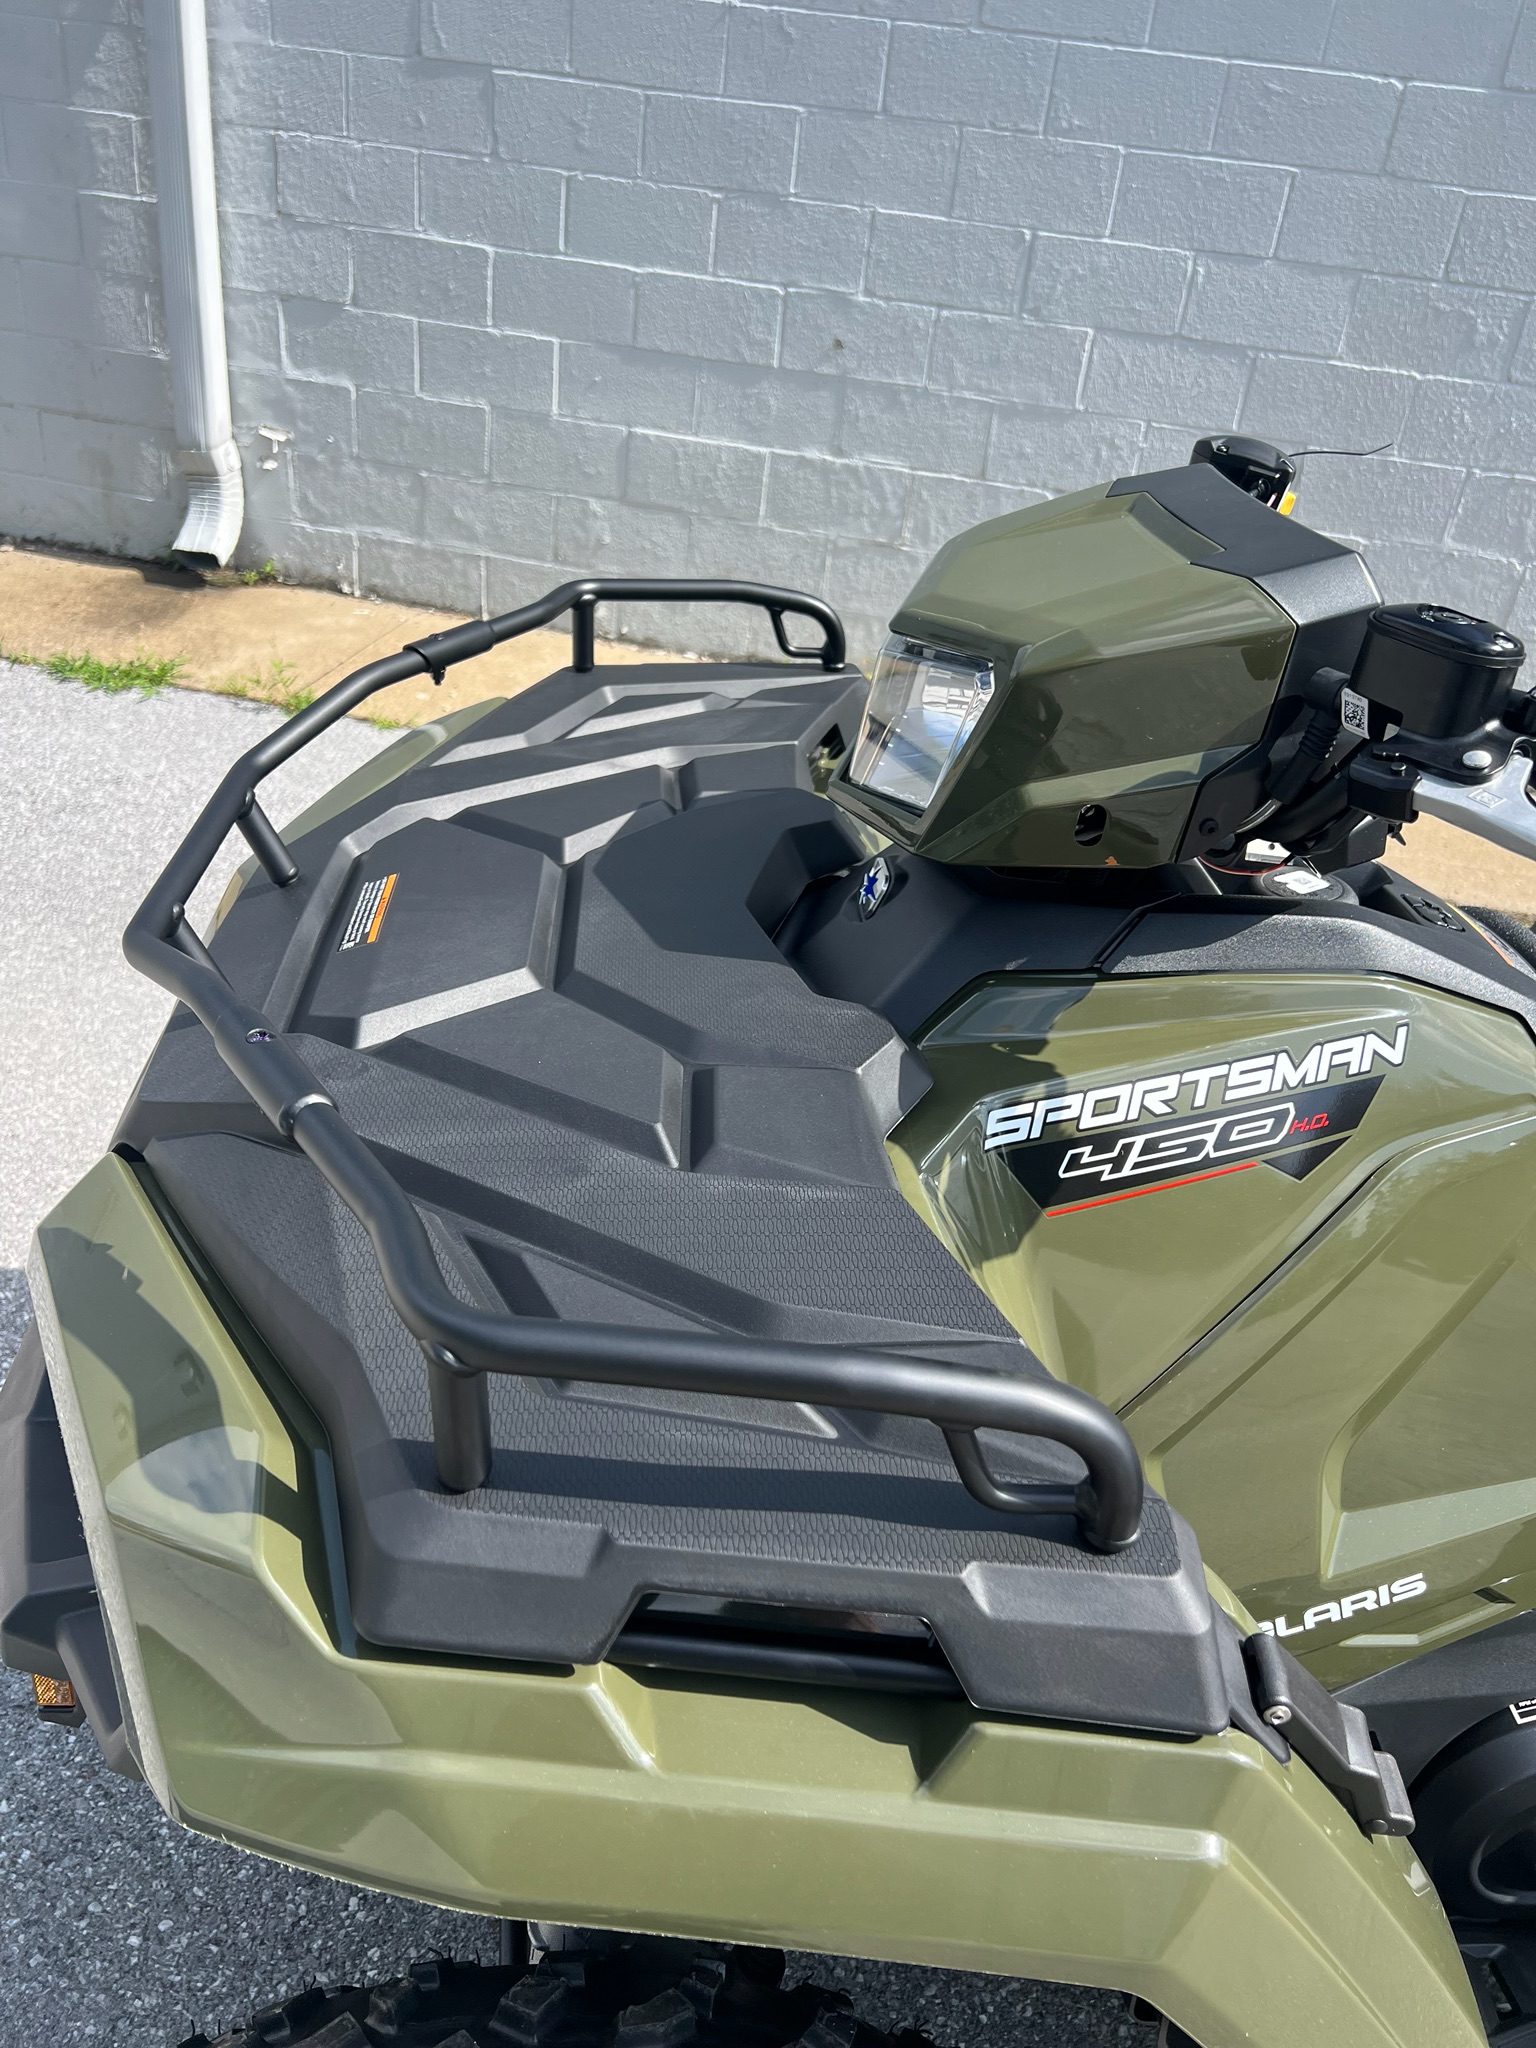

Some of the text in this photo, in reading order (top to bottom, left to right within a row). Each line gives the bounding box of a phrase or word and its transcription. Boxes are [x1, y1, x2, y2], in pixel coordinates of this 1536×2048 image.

[984, 1023, 1410, 1151] SPORTSMAN
[1058, 1102, 1330, 1182] 450 H.O.
